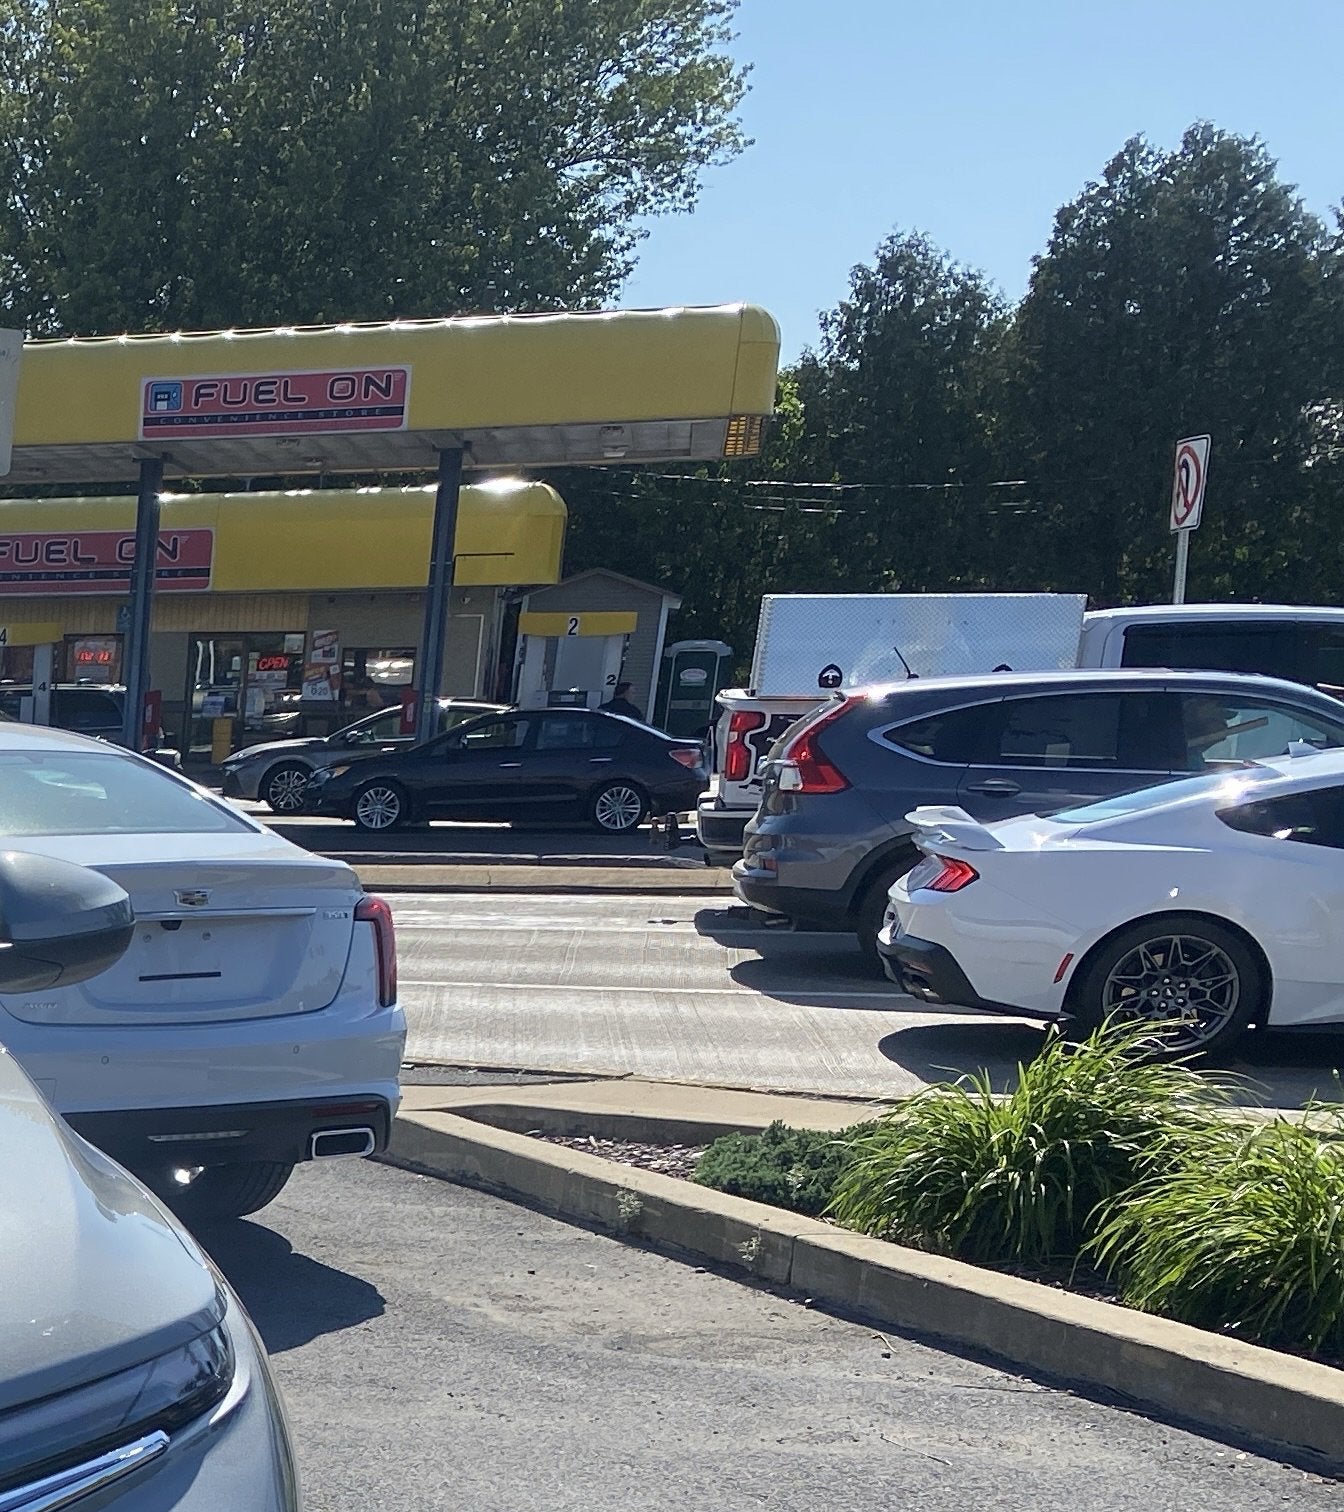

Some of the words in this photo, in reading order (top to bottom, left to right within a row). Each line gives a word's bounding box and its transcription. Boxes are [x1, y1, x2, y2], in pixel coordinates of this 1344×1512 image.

[193, 378, 307, 409] FUEL
[327, 372, 394, 402] ON
[159, 412, 305, 425] CONVENIENCE
[318, 407, 383, 419] STORE
[567, 617, 579, 636] 2
[258, 655, 289, 671] OPEN
[38, 681, 47, 692] 4
[606, 674, 616, 686] 2
